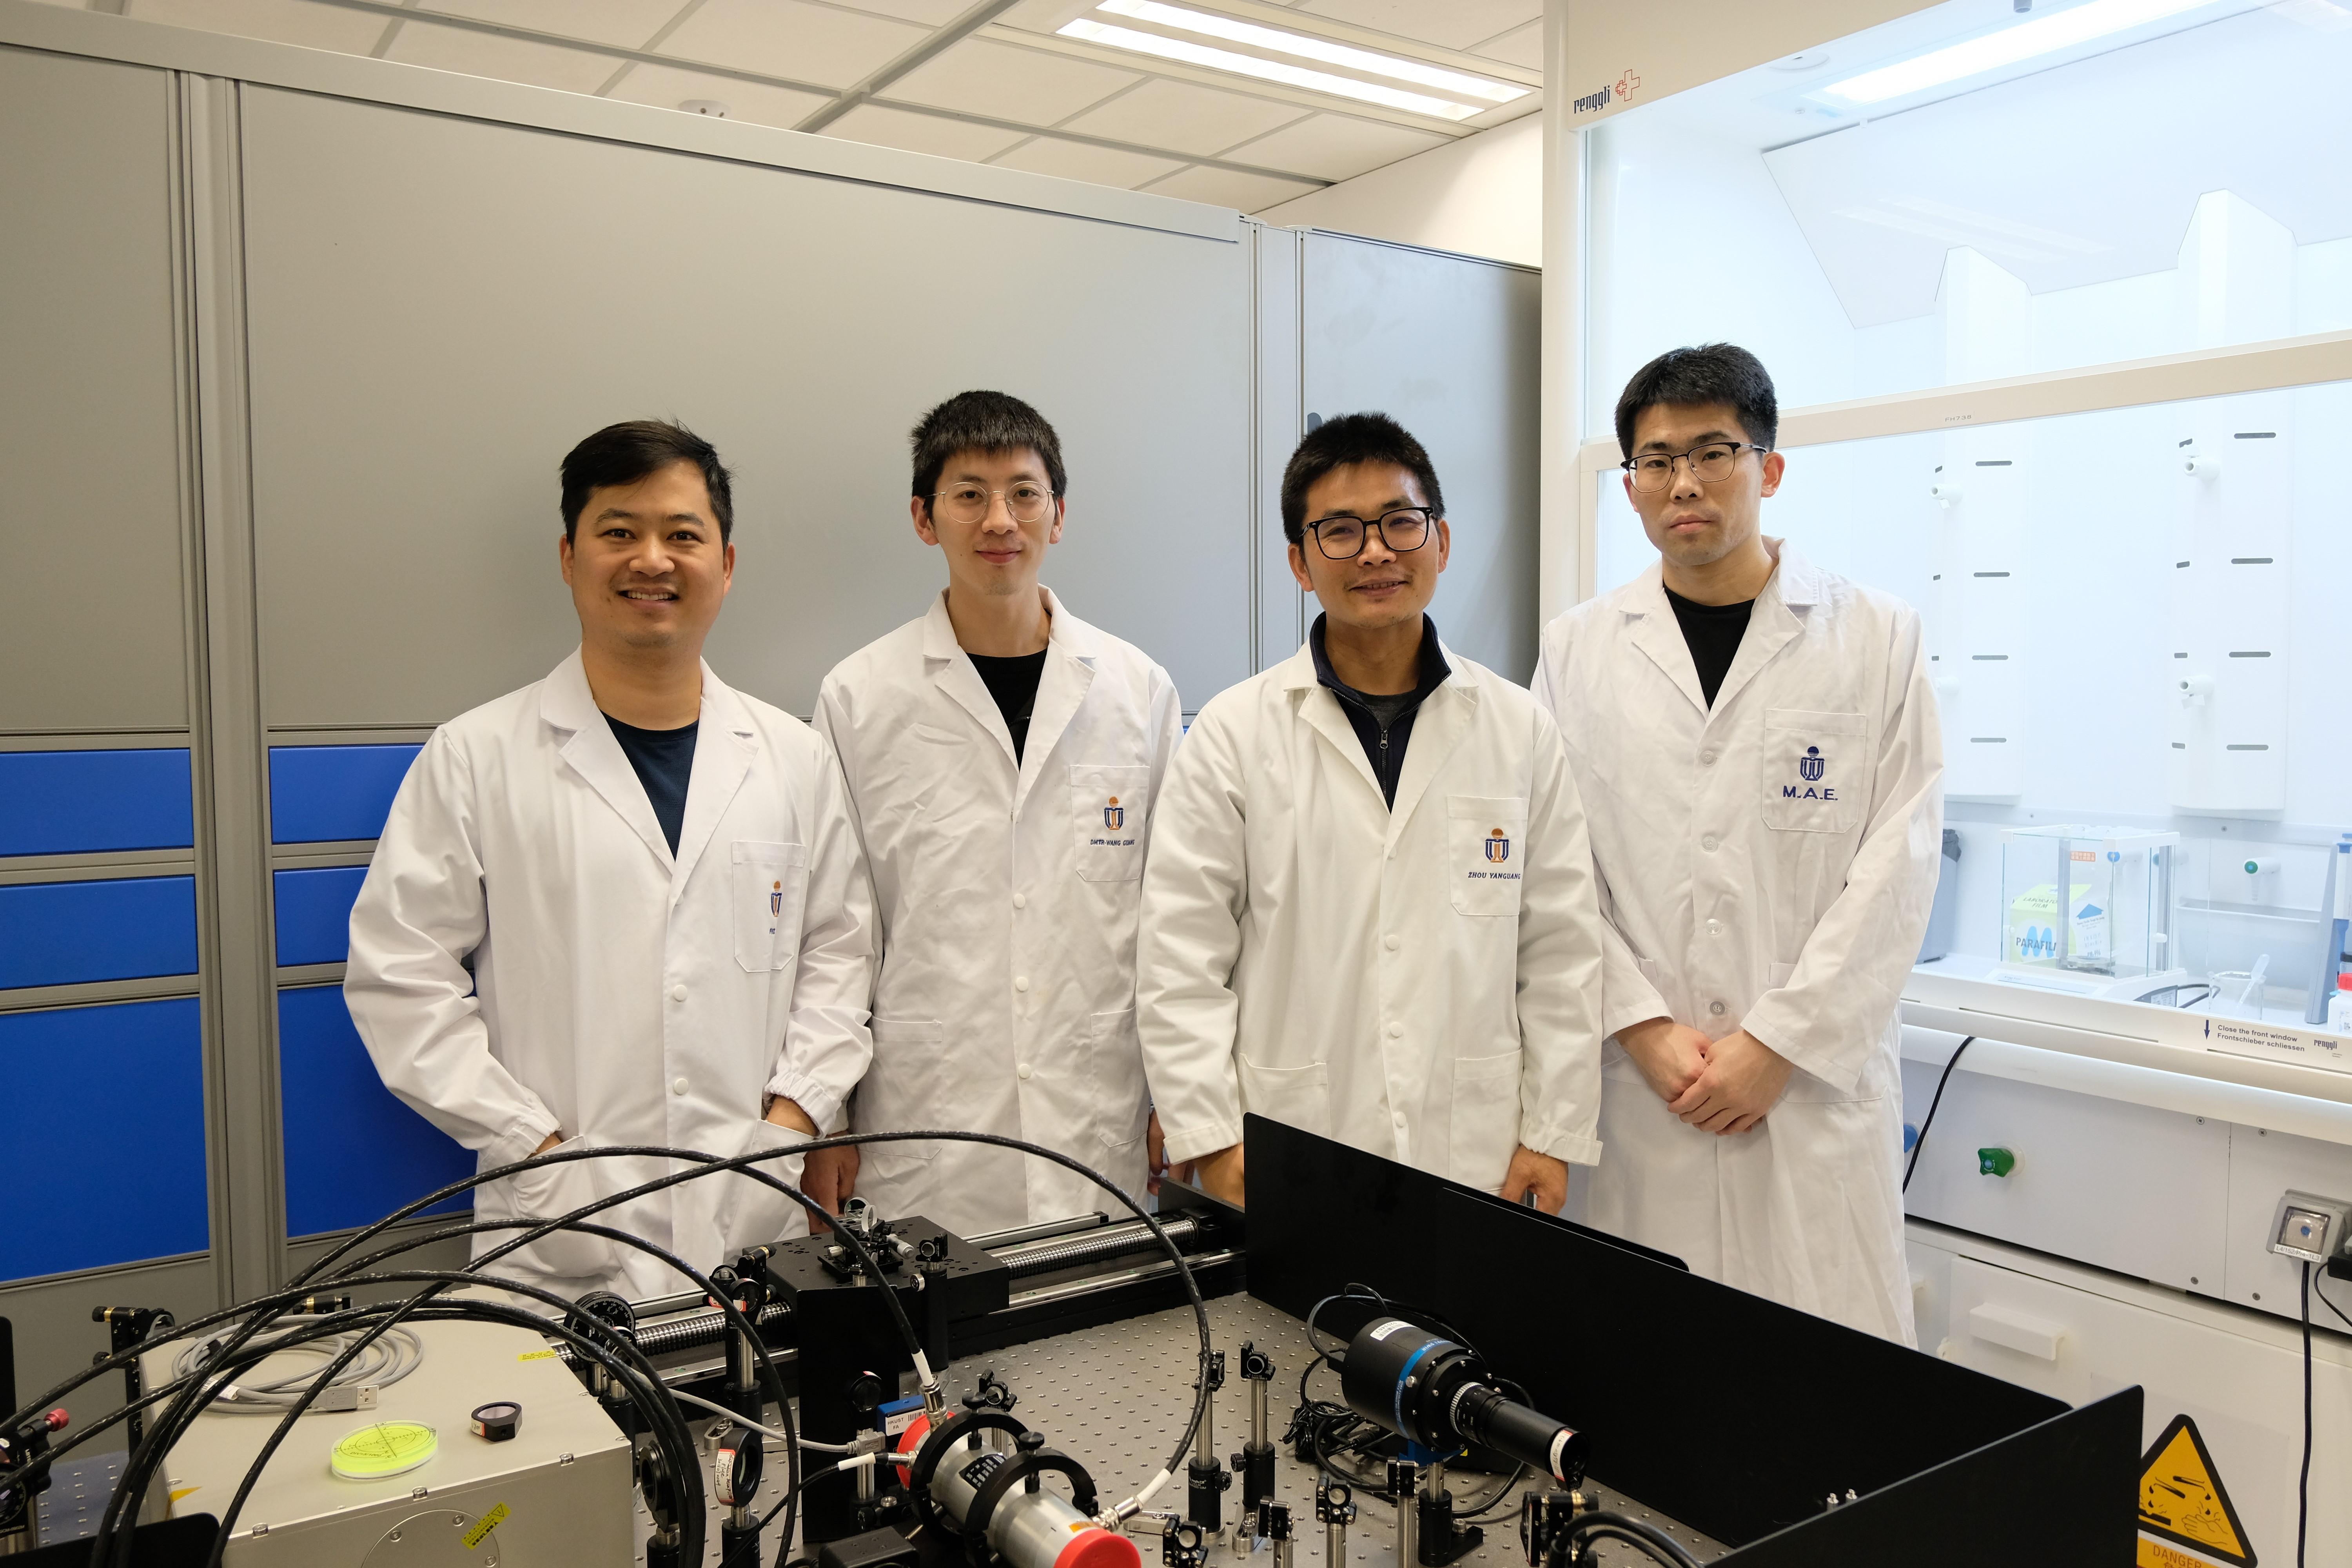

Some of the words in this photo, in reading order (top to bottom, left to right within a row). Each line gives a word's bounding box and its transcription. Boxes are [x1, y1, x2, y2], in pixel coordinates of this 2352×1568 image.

[1573, 85, 1610, 114] renggli
[1783, 785, 1838, 800] M.A.E.
[2218, 1024, 2237, 1033] Close
[2252, 1030, 2269, 1038] front
[2270, 1033, 2298, 1042] window
[2217, 1033, 2265, 1046] Frontschieber
[2267, 1041, 2305, 1052] schliessen
[2314, 1040, 2337, 1050] renggli
[2153, 1544, 2202, 1568] DANGER
